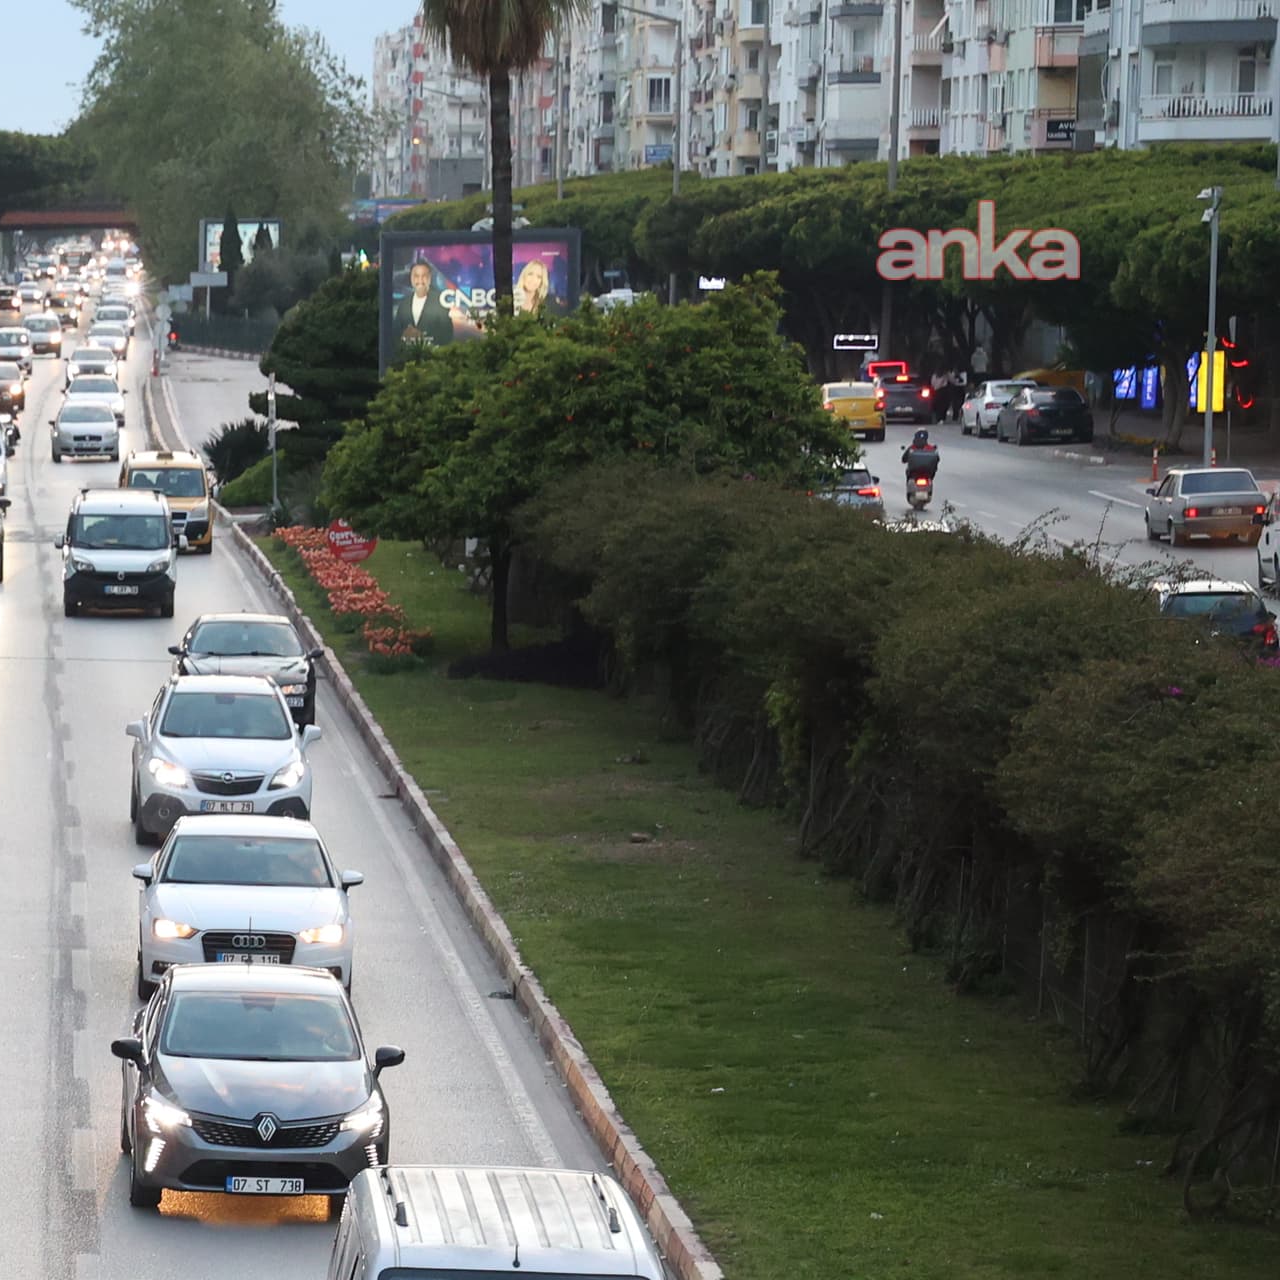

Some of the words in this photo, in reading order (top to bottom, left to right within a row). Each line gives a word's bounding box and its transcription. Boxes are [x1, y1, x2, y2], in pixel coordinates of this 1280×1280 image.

[233, 1178, 248, 1191] 07
[256, 1179, 271, 1192] ST
[280, 1180, 302, 1193] 738
